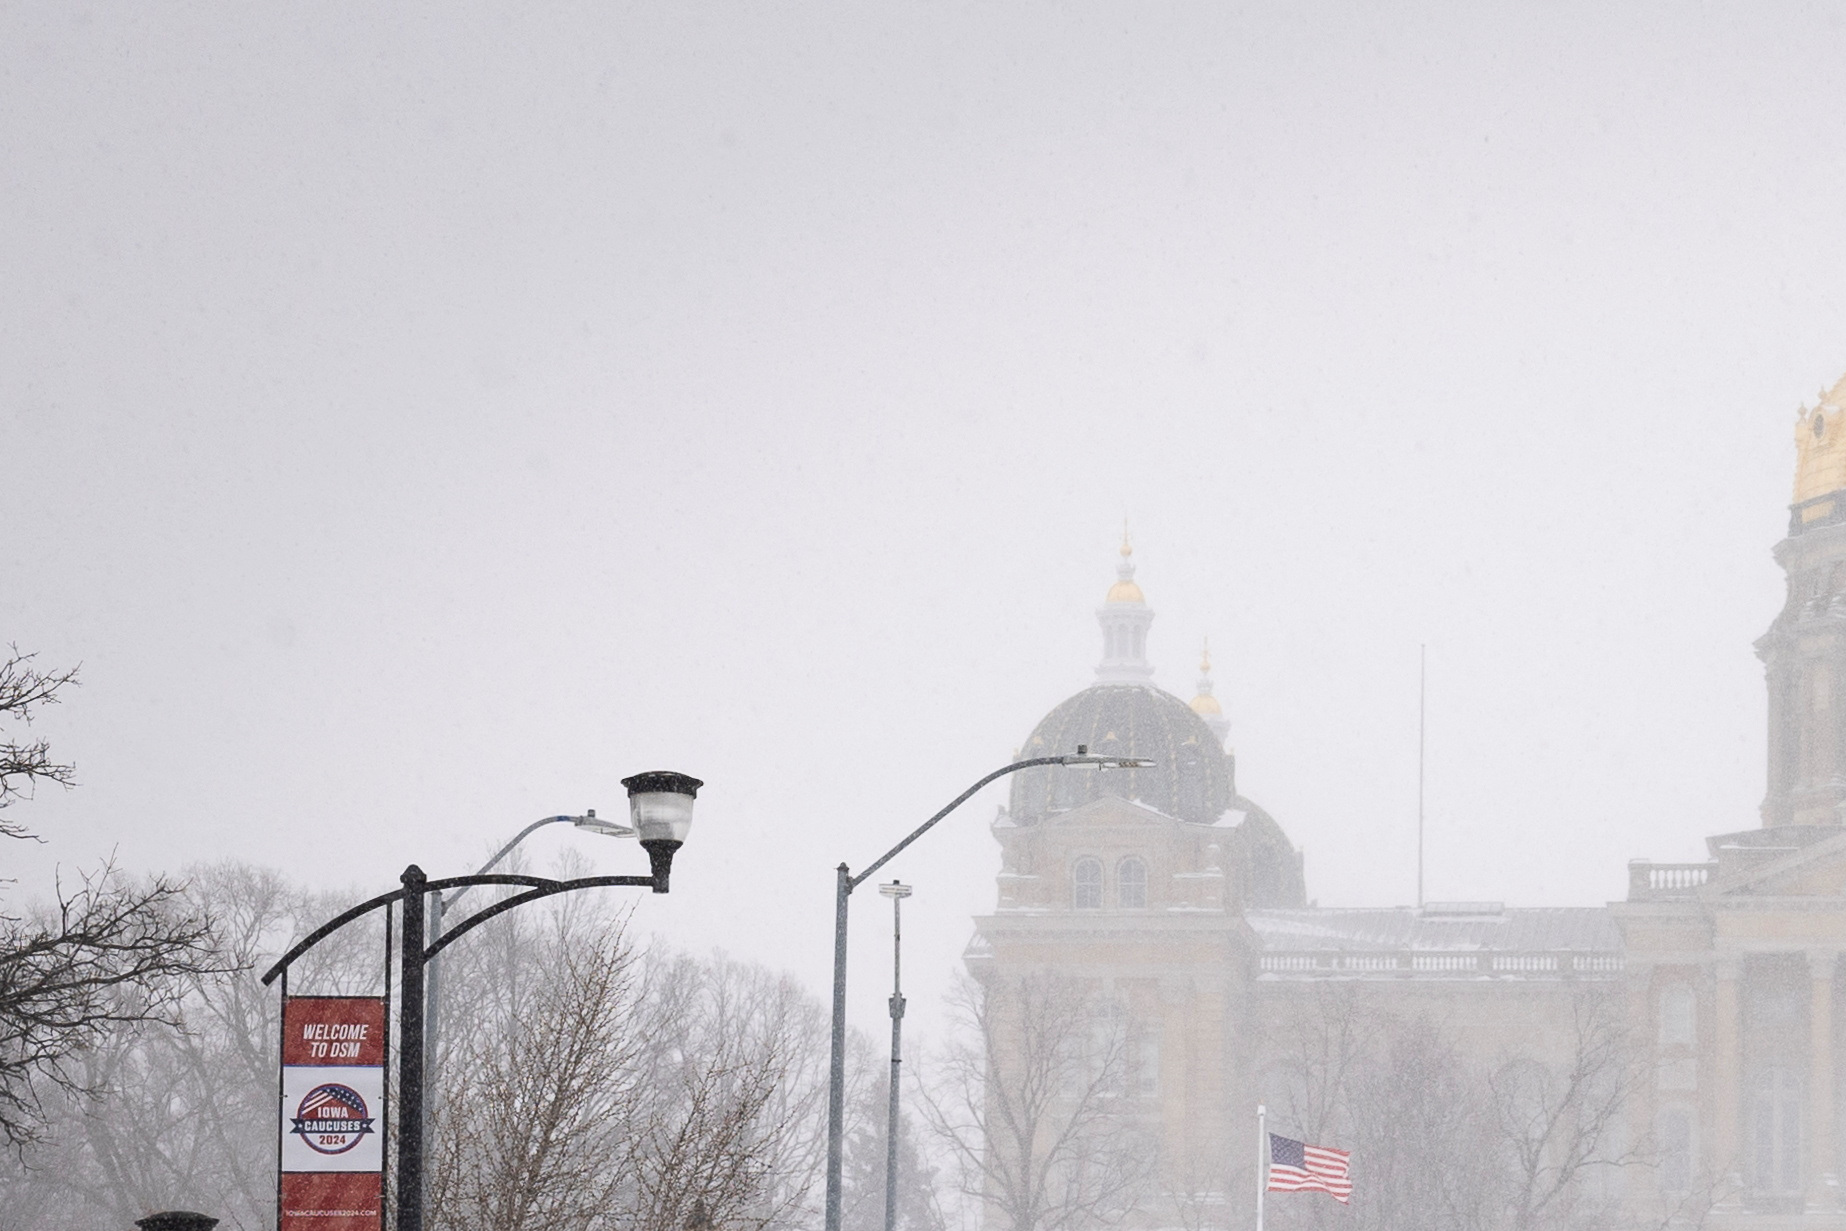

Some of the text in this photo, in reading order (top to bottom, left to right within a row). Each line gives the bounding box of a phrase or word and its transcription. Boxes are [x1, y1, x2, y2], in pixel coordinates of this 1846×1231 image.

[303, 1023, 369, 1041] WELCOME
[311, 1042, 360, 1058] TO DSM
[317, 1106, 348, 1119] IOWA
[304, 1120, 361, 1132] CAUCUSES
[319, 1134, 346, 1146] 2024
